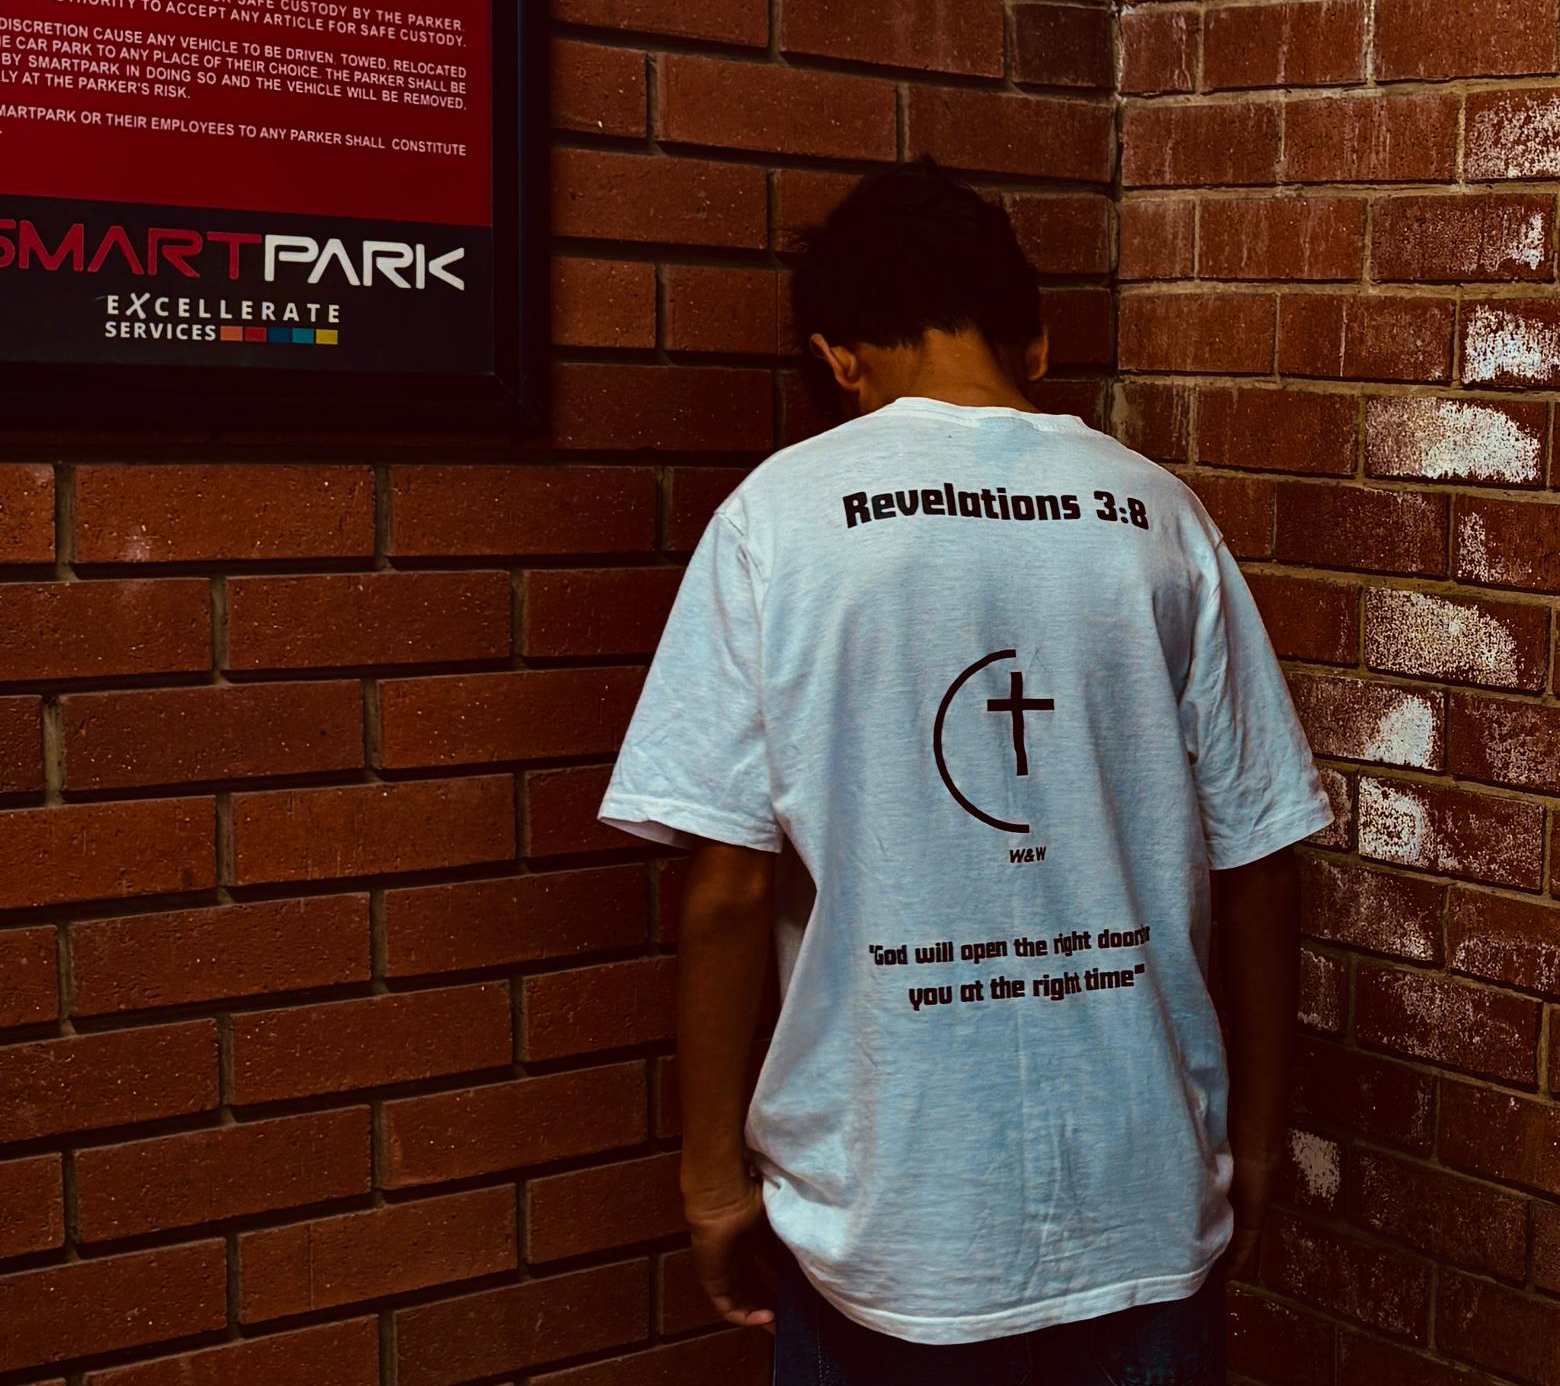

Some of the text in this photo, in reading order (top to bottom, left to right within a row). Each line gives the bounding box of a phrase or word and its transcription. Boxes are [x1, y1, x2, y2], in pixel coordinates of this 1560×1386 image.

[166, 1, 226, 19] ACCEPT
[230, 8, 259, 23] ANY
[263, 12, 324, 31] ARTICLE
[329, 20, 356, 34] FOR
[360, 24, 396, 39] SAFE
[353, 7, 370, 20] BY
[376, 10, 402, 24] THE
[2, 52, 21, 66] BY
[28, 55, 120, 75] SMARTPARK
[126, 64, 139, 77] IN
[146, 66, 191, 82] DOING
[197, 71, 216, 85] SO
[221, 74, 250, 88] AND
[256, 77, 281, 91] THE
[287, 80, 342, 97] VEHICLE
[347, 86, 377, 101] WILL
[382, 90, 398, 103] BE
[80, 111, 101, 125] OR
[106, 113, 147, 128] THEIR
[151, 117, 234, 136] EMPLOYEES
[239, 124, 257, 138] TO
[259, 127, 286, 140] ANY
[290, 129, 342, 145] PARKER
[345, 134, 385, 149] SHALL
[392, 138, 466, 156] CONSTITUTE
[105, 293, 340, 323] EXCELLERATE
[105, 321, 216, 341] SERVICES
[843, 483, 1149, 530] Revelations 3:8
[1009, 846, 1047, 864] W&W
[914, 941, 955, 965] will
[960, 941, 1008, 965] open
[1014, 937, 1049, 958] the
[1053, 930, 1092, 958] right
[909, 986, 953, 1012] you
[960, 980, 985, 1003] at
[990, 976, 1026, 1000] the
[1033, 971, 1083, 1001] right
